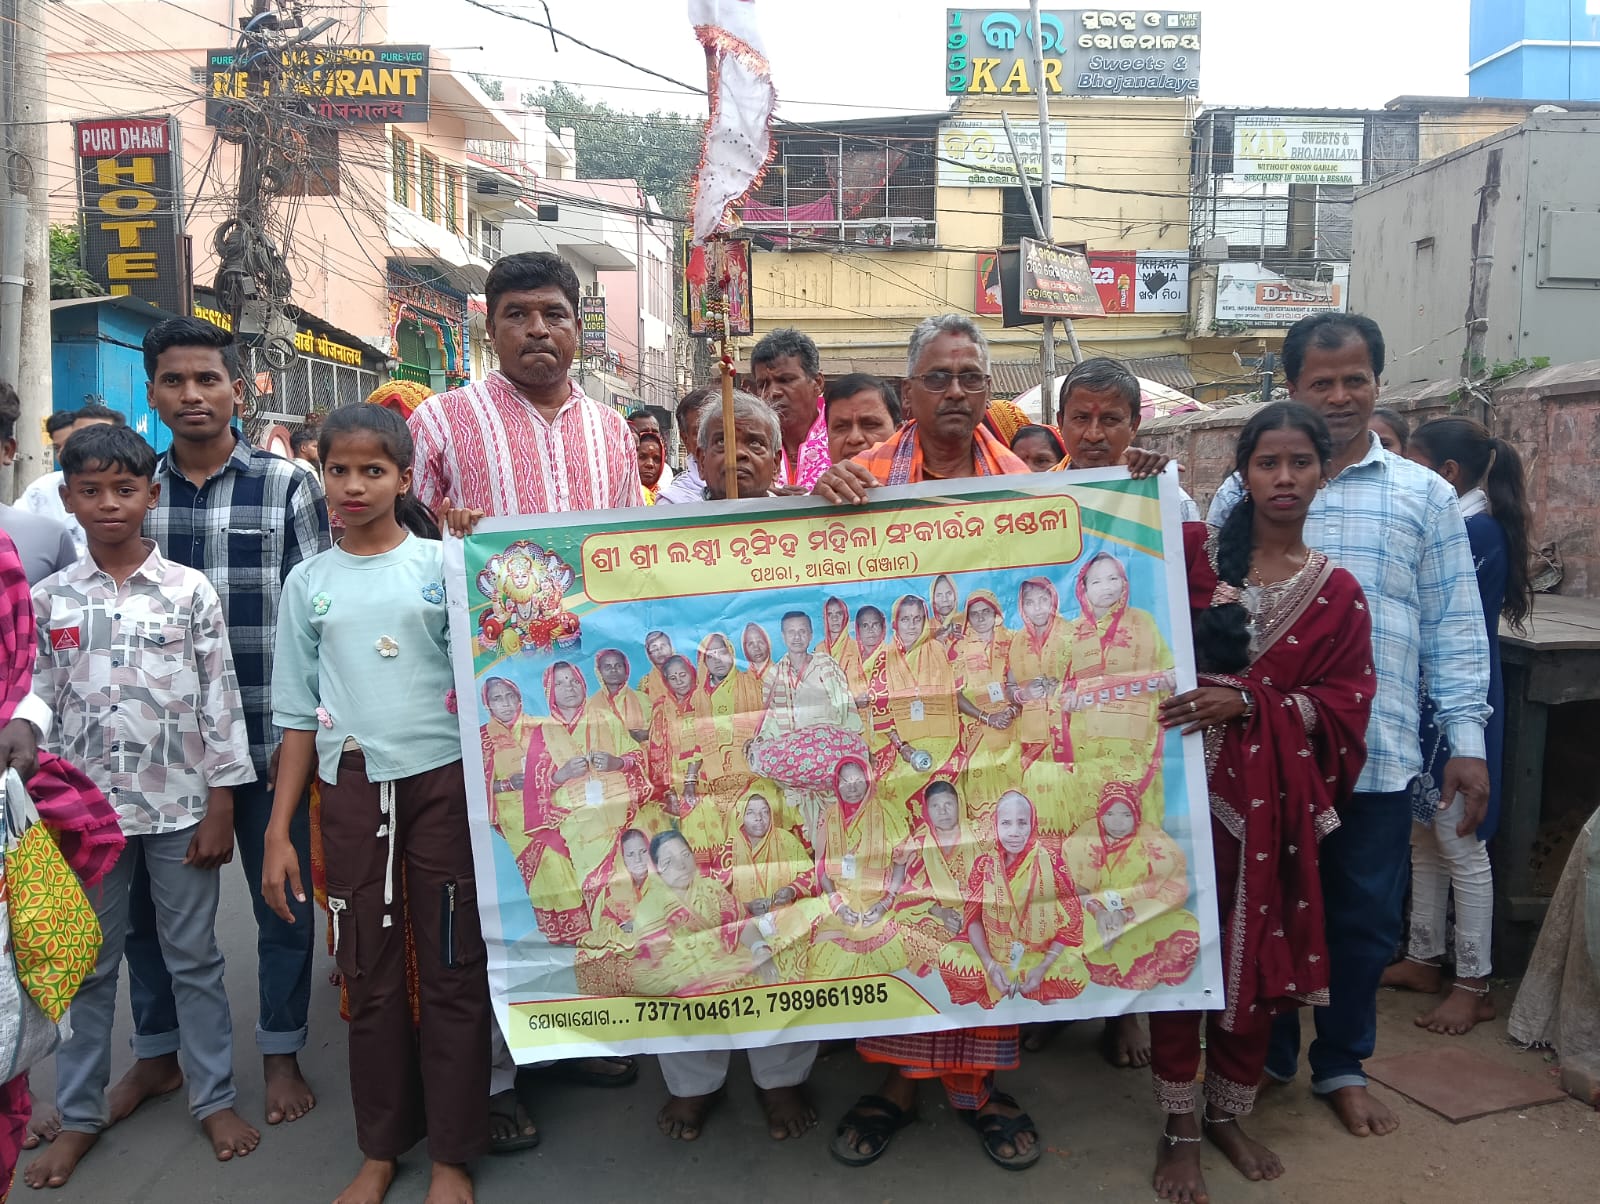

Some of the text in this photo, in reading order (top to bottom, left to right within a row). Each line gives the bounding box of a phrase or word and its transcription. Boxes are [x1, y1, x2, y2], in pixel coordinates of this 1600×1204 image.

[981, 12, 1067, 55] କର
[380, 52, 424, 62] PURE-VEG
[948, 11, 968, 92] 1952
[1089, 55, 1188, 72] Sweets &
[213, 68, 422, 98] RETAURANT
[968, 58, 1063, 93] KAR
[1078, 73, 1200, 93] Bhojanalaya
[82, 127, 164, 151] PURI DHAM
[1240, 128, 1288, 157] KAR
[1301, 131, 1341, 145] SWEETS
[1291, 146, 1358, 160] BHOJANALAYA
[1244, 173, 1284, 182] SPECIALIST
[1257, 163, 1289, 171] WITHOUT
[1313, 163, 1338, 172] GARLIC
[1141, 260, 1179, 270] KHATA
[584, 313, 604, 322] UMA
[317, 332, 362, 366] भोजनालय
[591, 546, 620, 573] ଶ୍ରୀ
[629, 543, 659, 570] ଶ୍ରୀ
[667, 538, 722, 567] ଲକ୍ଷ୍ମୀ
[807, 520, 878, 553] ମହିଳା
[994, 508, 1068, 535] ମଣ୍ଡଳୀ
[751, 565, 801, 583] ପଥରା,
[805, 557, 851, 578] ଆସିକା
[634, 995, 761, 1023] 7377104612,
[766, 982, 889, 1013] 7989661985
